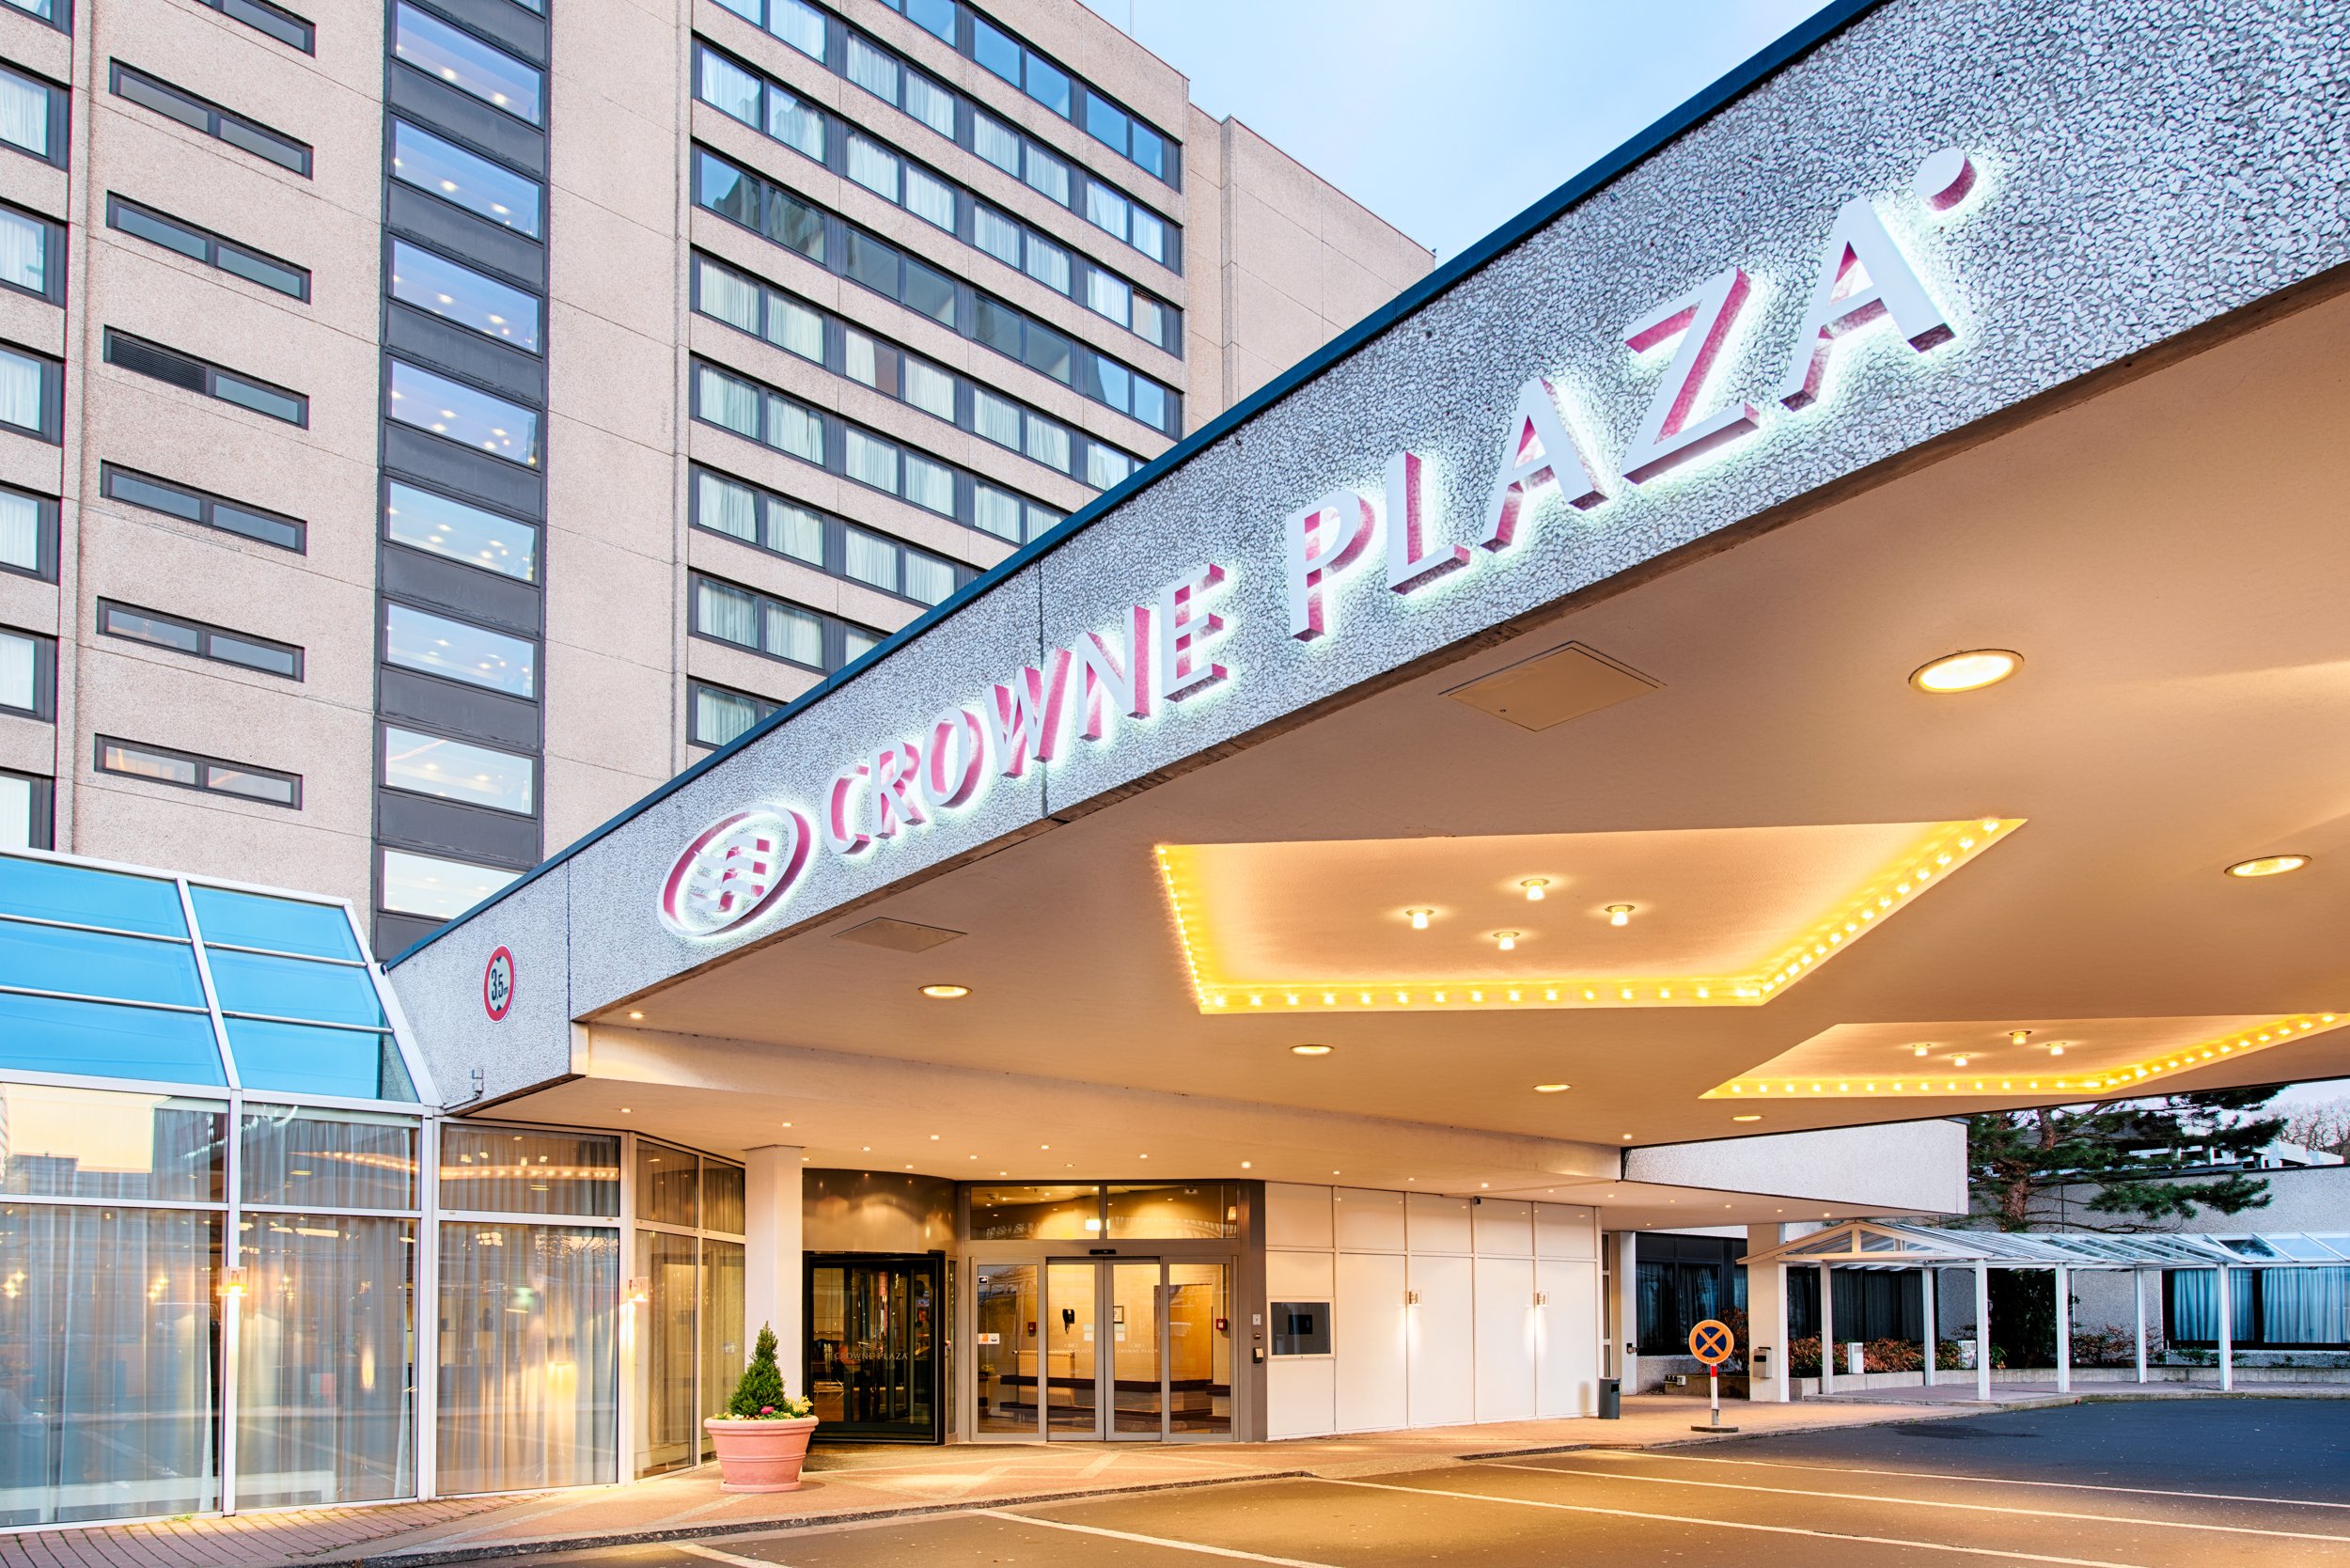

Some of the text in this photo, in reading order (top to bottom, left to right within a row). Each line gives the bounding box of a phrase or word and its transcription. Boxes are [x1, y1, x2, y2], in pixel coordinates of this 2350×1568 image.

[822, 193, 1957, 855] CROWNE PLAZA
[834, 1352, 908, 1360] CROWNE PLAZA
